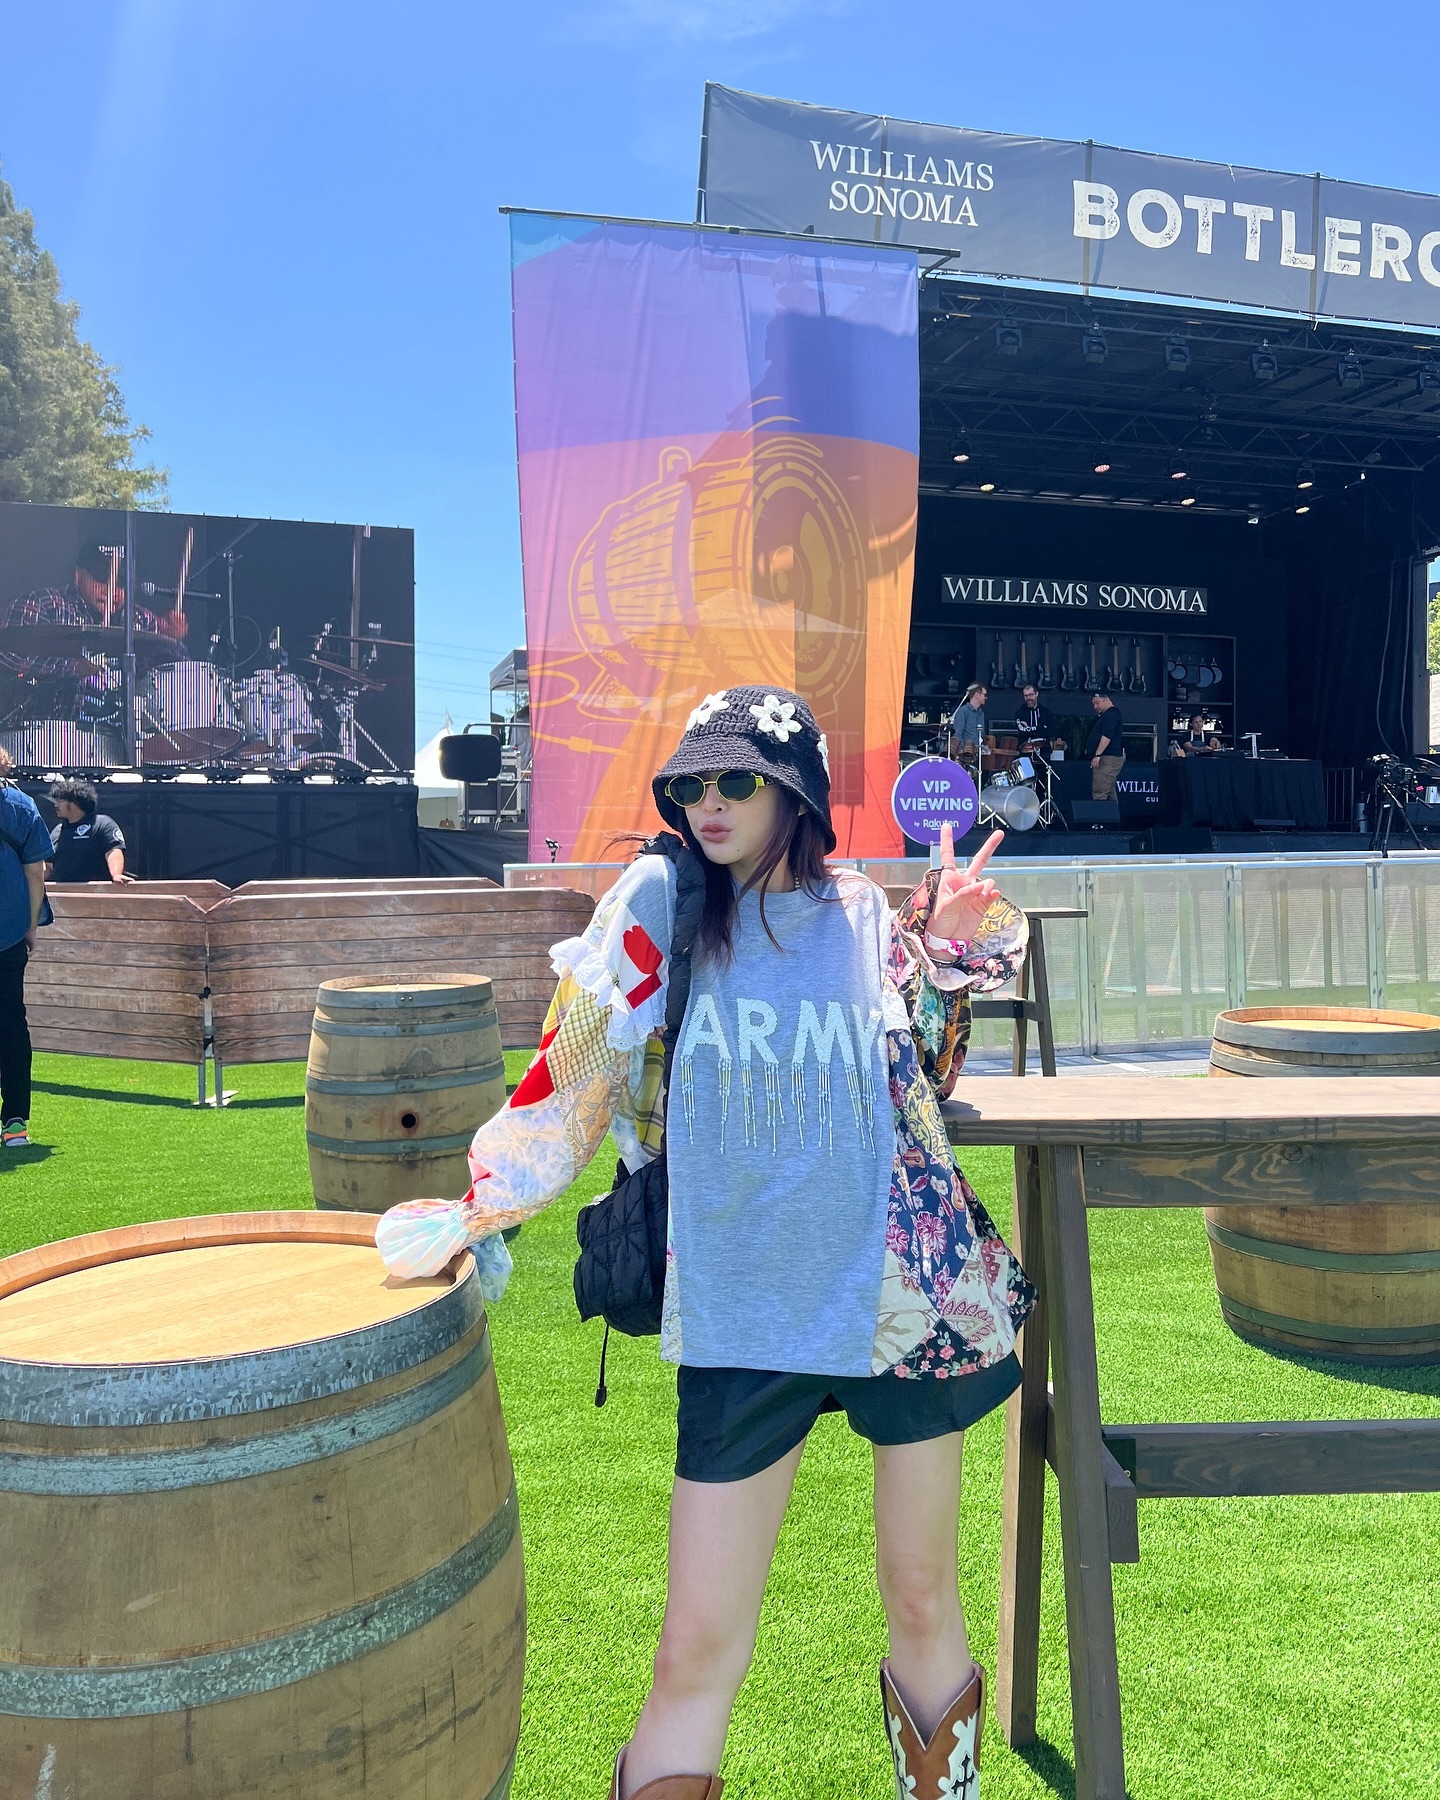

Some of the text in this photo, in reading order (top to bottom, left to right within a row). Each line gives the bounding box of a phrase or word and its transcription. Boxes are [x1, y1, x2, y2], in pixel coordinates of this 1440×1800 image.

[809, 140, 994, 192] WILLIAMS
[829, 180, 978, 227] SONOMA
[943, 576, 1207, 613] WILLIAMS SONOMA
[899, 797, 974, 811] VIEWING
[922, 780, 951, 793] VIP
[680, 994, 883, 1069] ARMY
